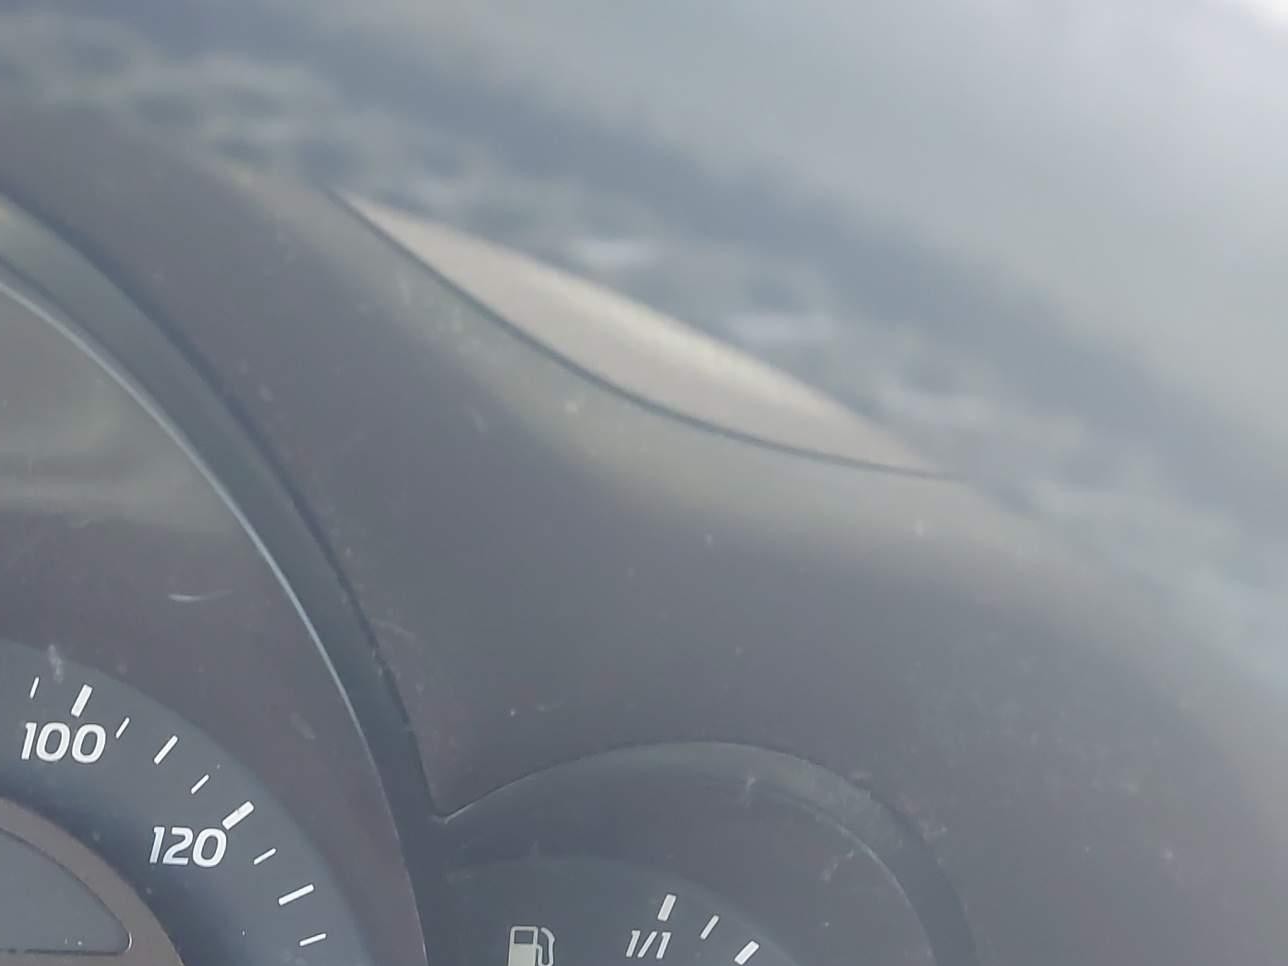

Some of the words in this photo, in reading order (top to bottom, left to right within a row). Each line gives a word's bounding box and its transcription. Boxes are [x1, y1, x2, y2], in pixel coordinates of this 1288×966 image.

[20, 722, 107, 764] 100
[149, 826, 227, 867] 120
[625, 930, 671, 959] 1/1
